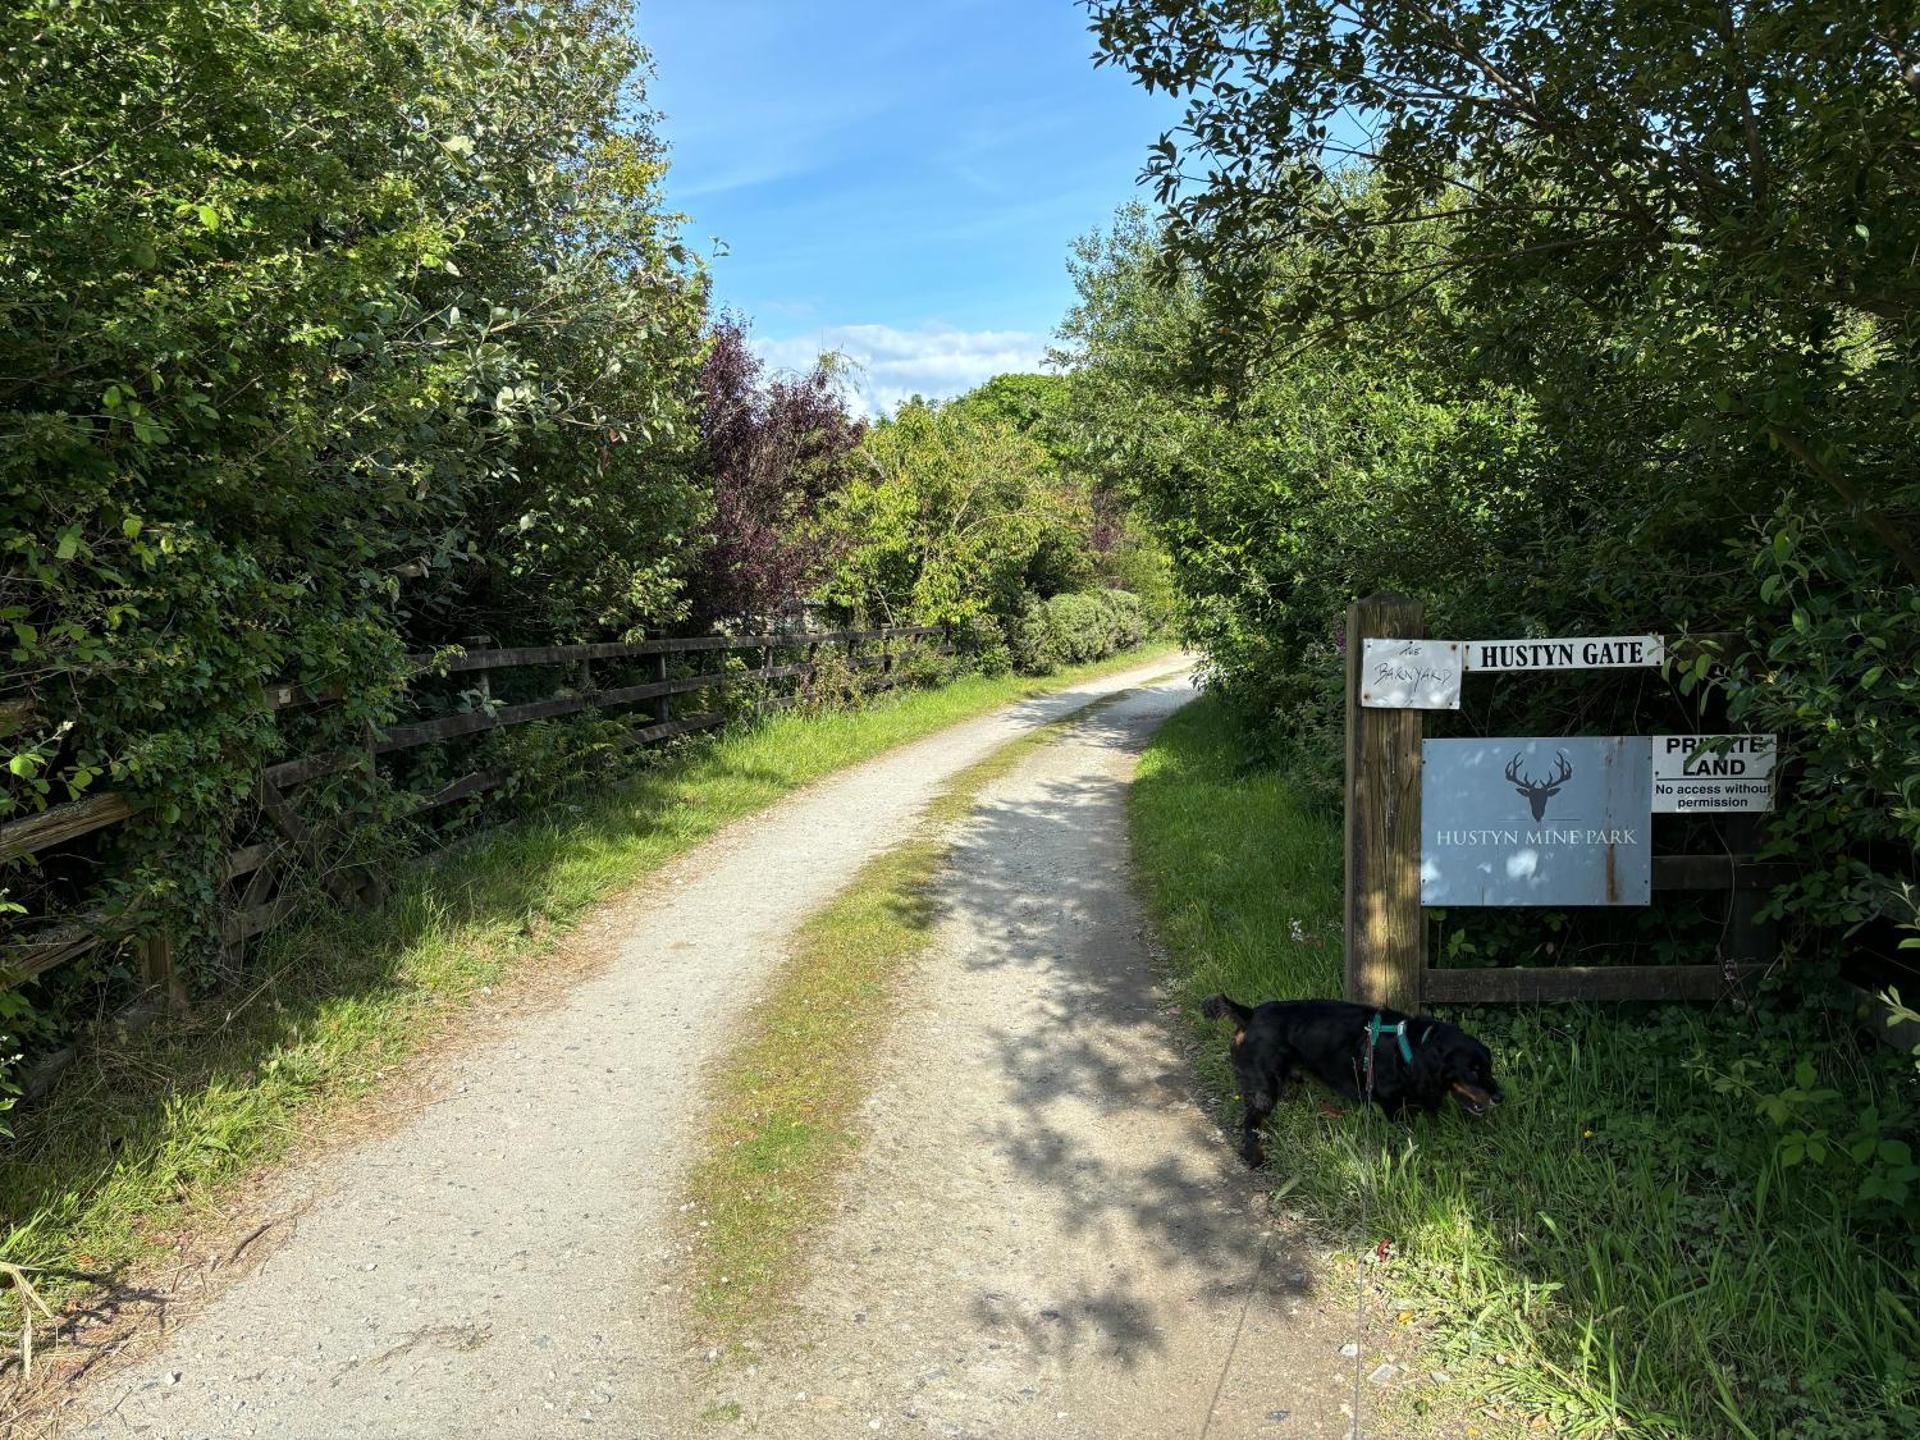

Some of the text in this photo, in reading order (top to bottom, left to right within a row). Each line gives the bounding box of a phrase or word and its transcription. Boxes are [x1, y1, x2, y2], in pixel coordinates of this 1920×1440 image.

[1481, 642, 1643, 667] HUSTYN GATE
[1683, 759, 1746, 776] LAND
[1655, 784, 1673, 794] No
[1677, 785, 1721, 794] access
[1678, 797, 1748, 808] permission
[1437, 829, 1638, 845] HUSTYN MINE PARK
